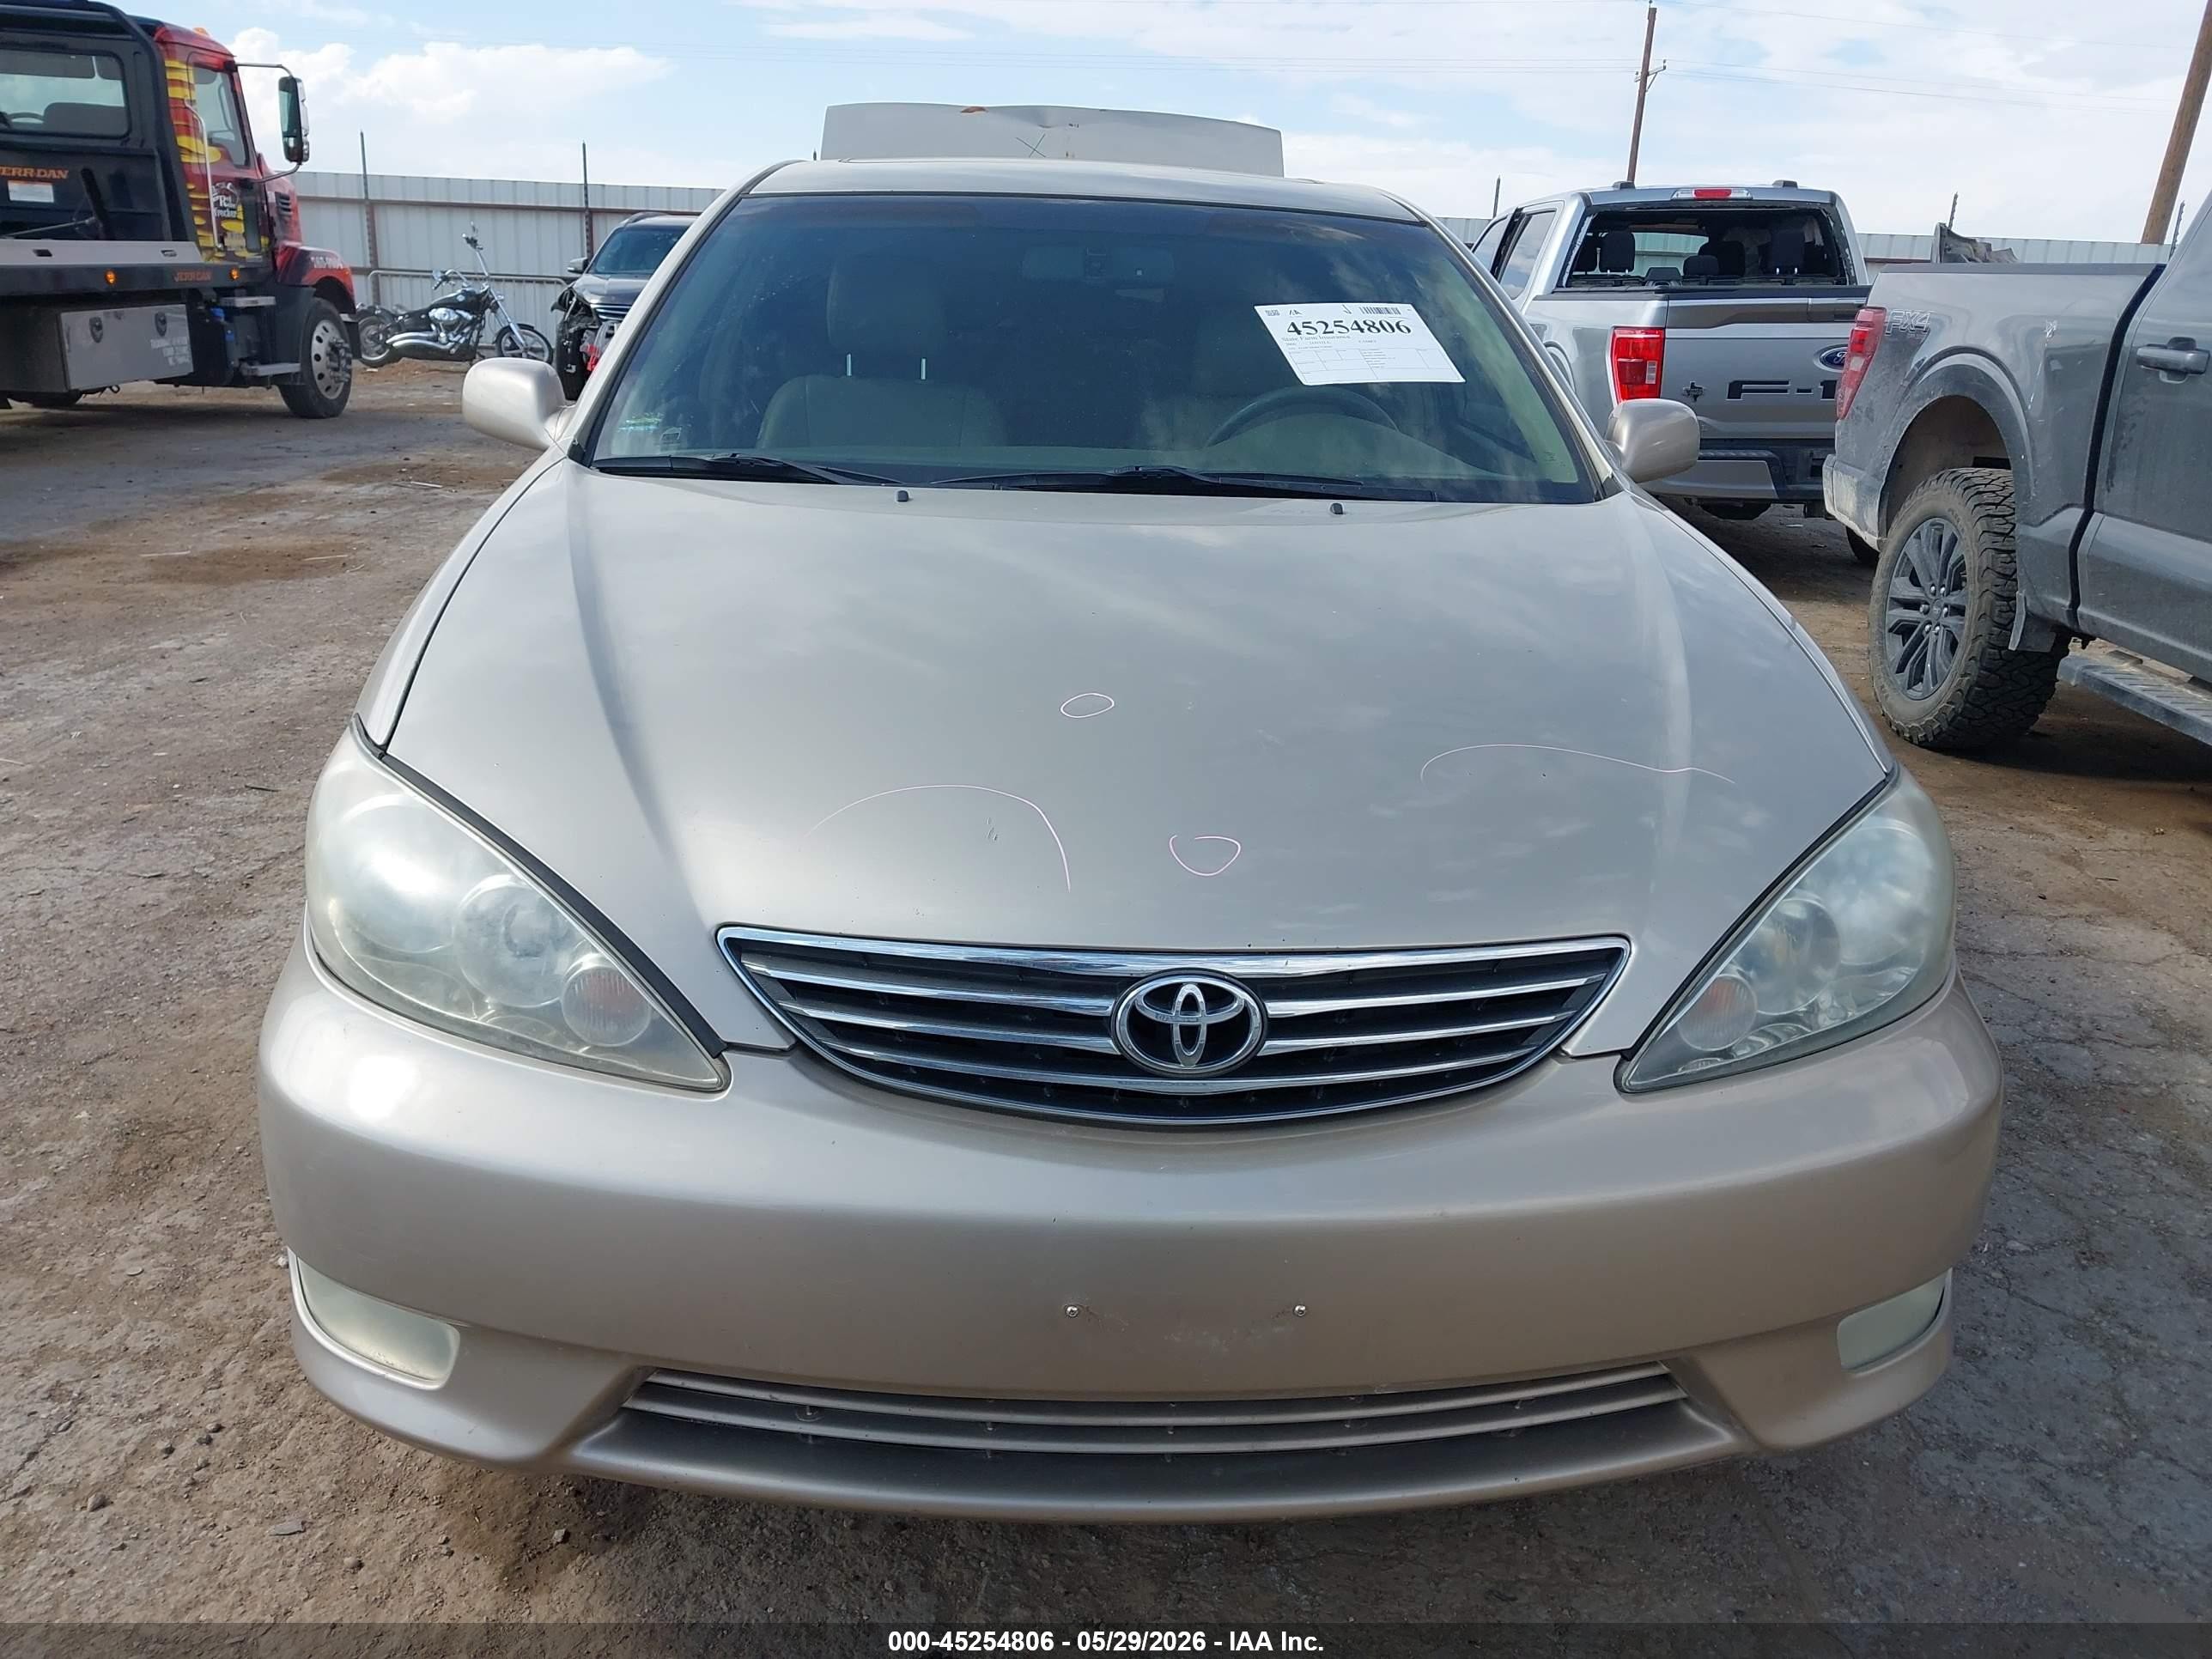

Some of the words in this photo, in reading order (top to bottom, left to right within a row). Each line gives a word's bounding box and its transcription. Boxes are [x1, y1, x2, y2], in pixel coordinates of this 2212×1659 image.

[0, 166, 69, 179] ERR-DAN
[1286, 318, 1411, 336] 45254806
[1885, 309, 1930, 336] FX4
